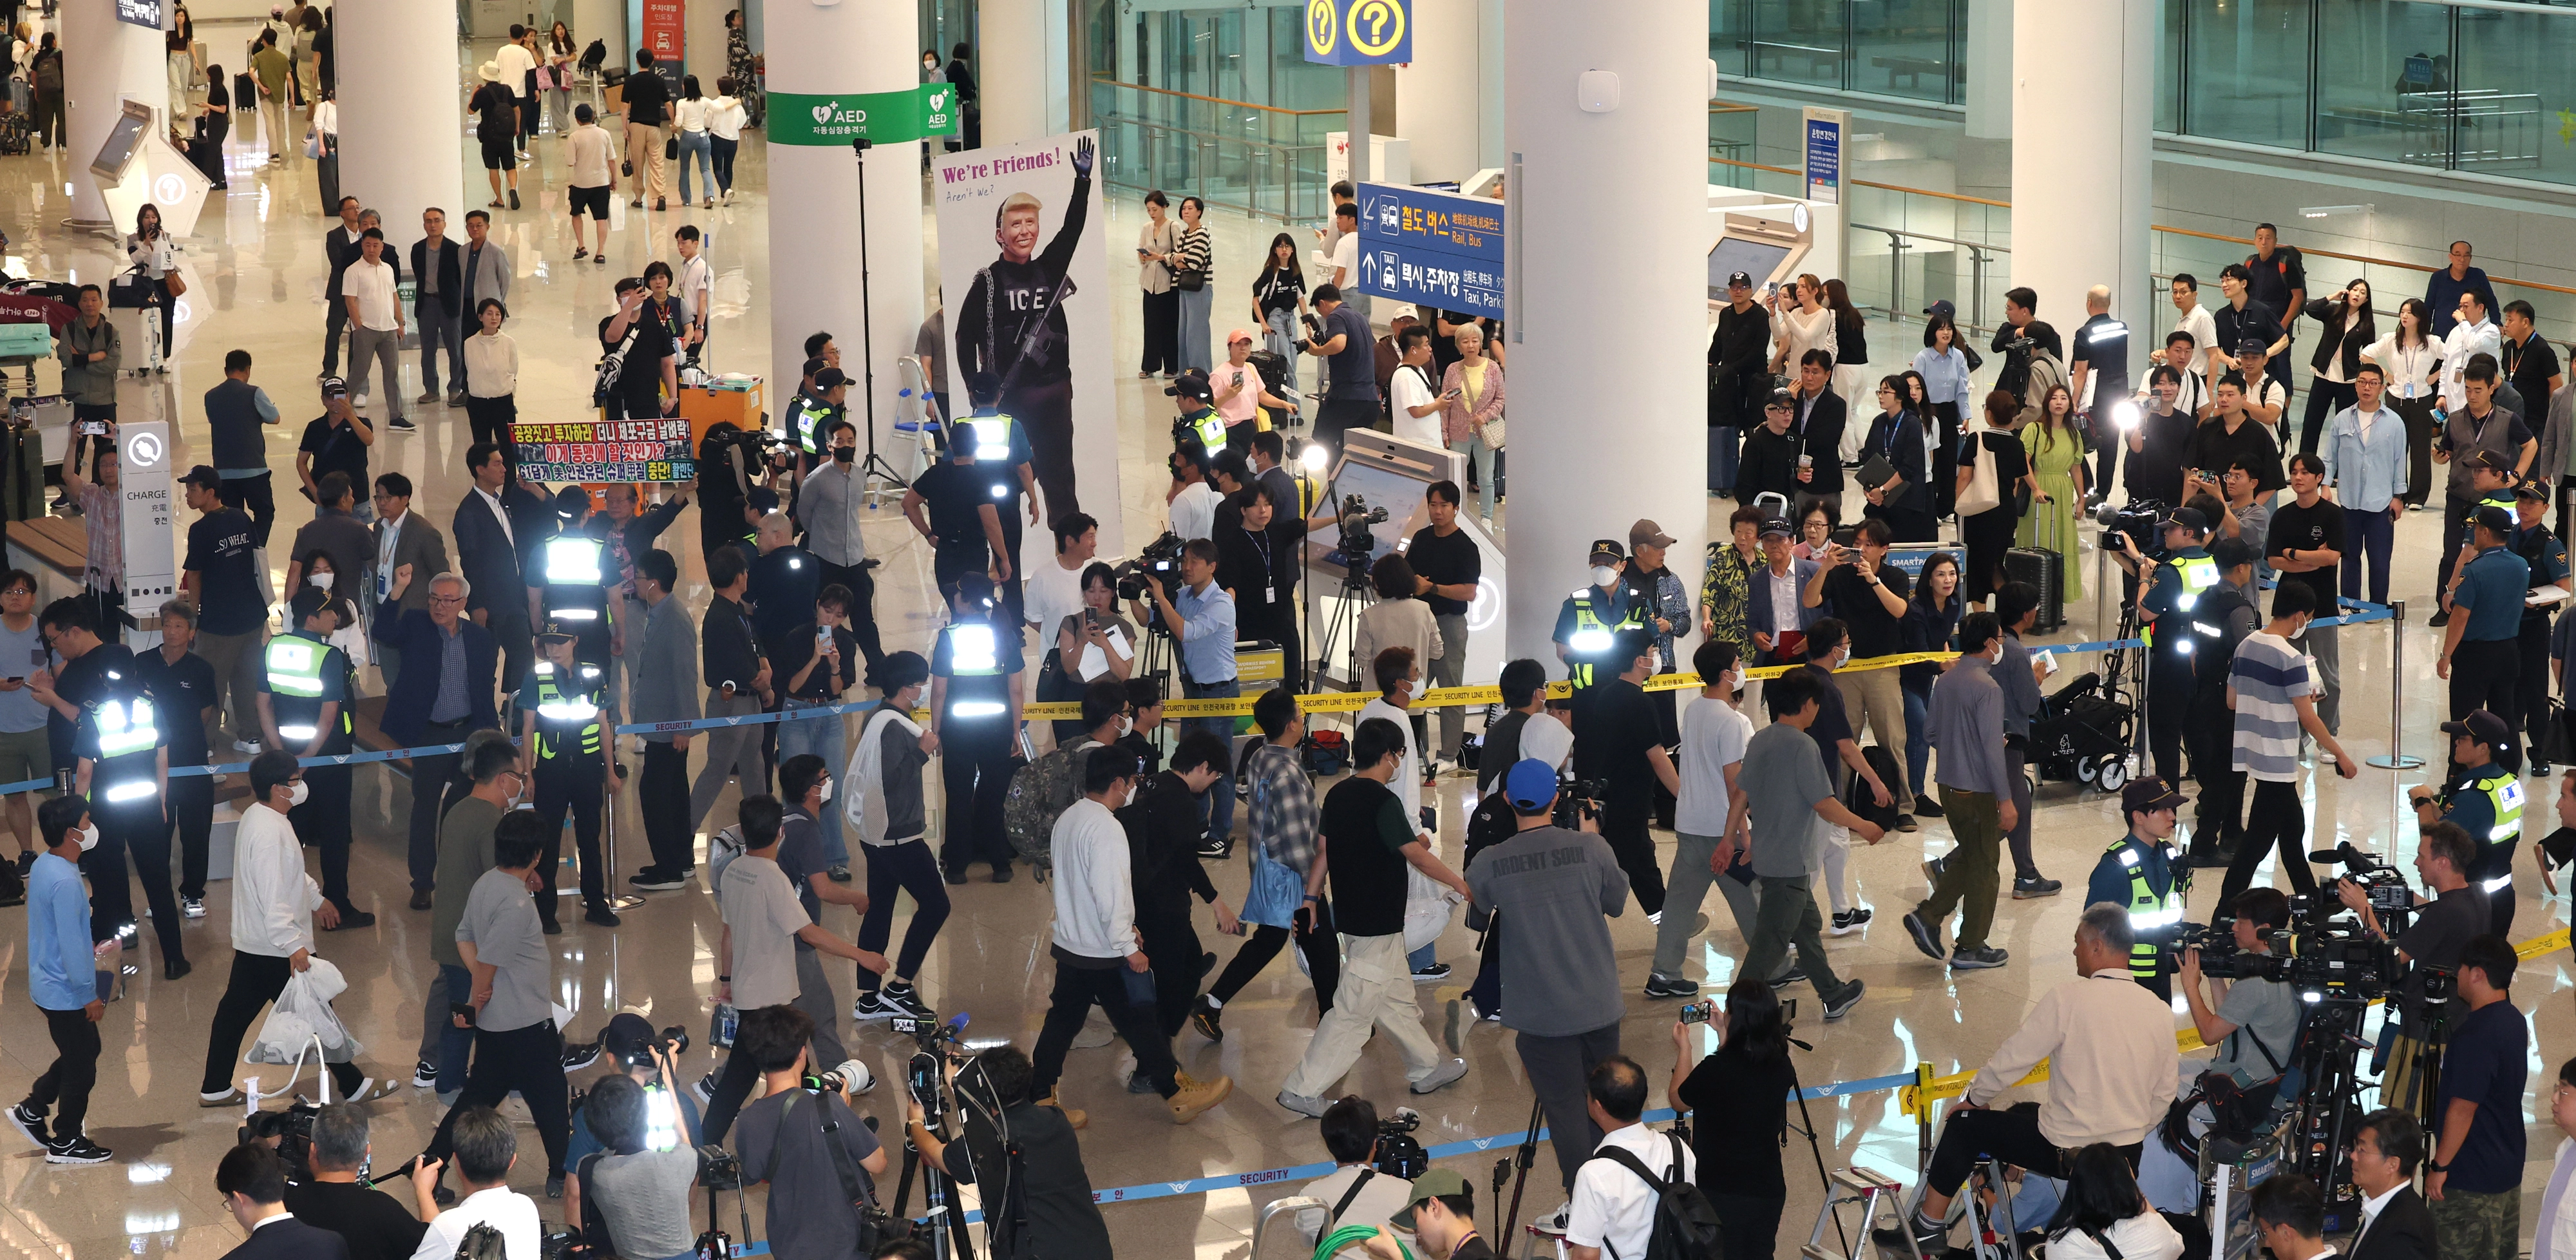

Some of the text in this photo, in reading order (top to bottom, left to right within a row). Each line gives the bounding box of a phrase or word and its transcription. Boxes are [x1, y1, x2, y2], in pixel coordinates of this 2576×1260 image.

[834, 110, 867, 123] AED
[928, 114, 947, 124] AED
[813, 126, 867, 135] 자동심장충격기
[1363, 222, 1370, 231] B1
[1402, 205, 1449, 236] 철도,버스
[1452, 231, 1482, 247] Rail, Bus
[1384, 254, 1394, 264] TAXI
[1402, 263, 1459, 297] 택시,주차장
[1463, 269, 1493, 287] 出租车,停车场
[1009, 288, 1045, 311] ICE
[1463, 289, 1504, 309] Taxi, Parki
[596, 423, 615, 442] 더니
[618, 422, 656, 442] 체포구금
[658, 420, 690, 441] 날벼락!
[545, 442, 666, 464] 이게 동맹에 할 짓인가?
[518, 464, 553, 481] G1답게
[648, 463, 670, 481] 중단!
[672, 462, 694, 479] 활빈단
[127, 490, 167, 501] CHARGE
[151, 504, 167, 512] 充電
[228, 533, 250, 548] WHAT.
[1444, 692, 1470, 700] SECURITY
[656, 721, 692, 731] SECURITY
[1492, 846, 1588, 878] ARDENT SOUL
[1240, 1170, 1289, 1185] SECURITY
